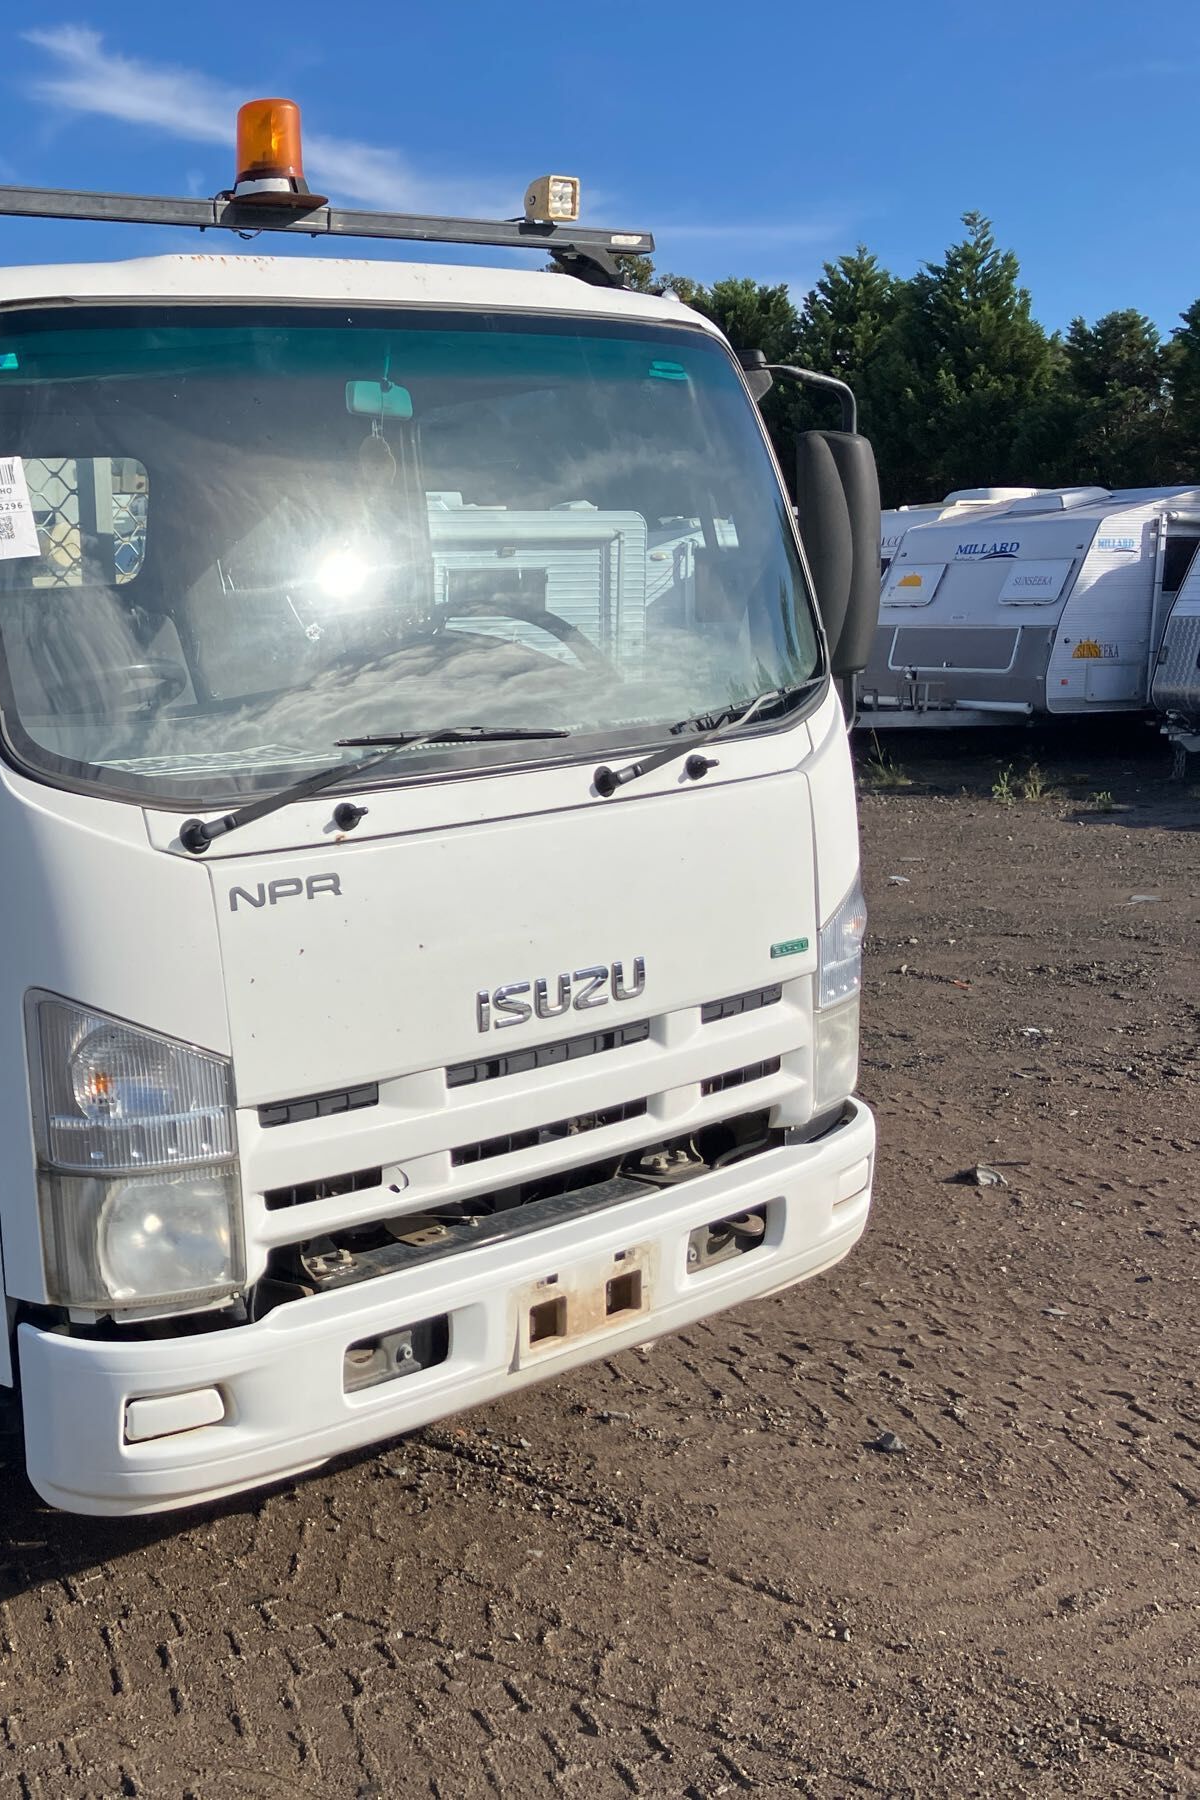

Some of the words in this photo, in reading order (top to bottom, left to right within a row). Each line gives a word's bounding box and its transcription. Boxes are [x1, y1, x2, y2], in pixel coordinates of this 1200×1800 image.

[955, 541, 1020, 556] MILLARD
[228, 872, 343, 912] NPR
[476, 955, 646, 1034] ISUZU
